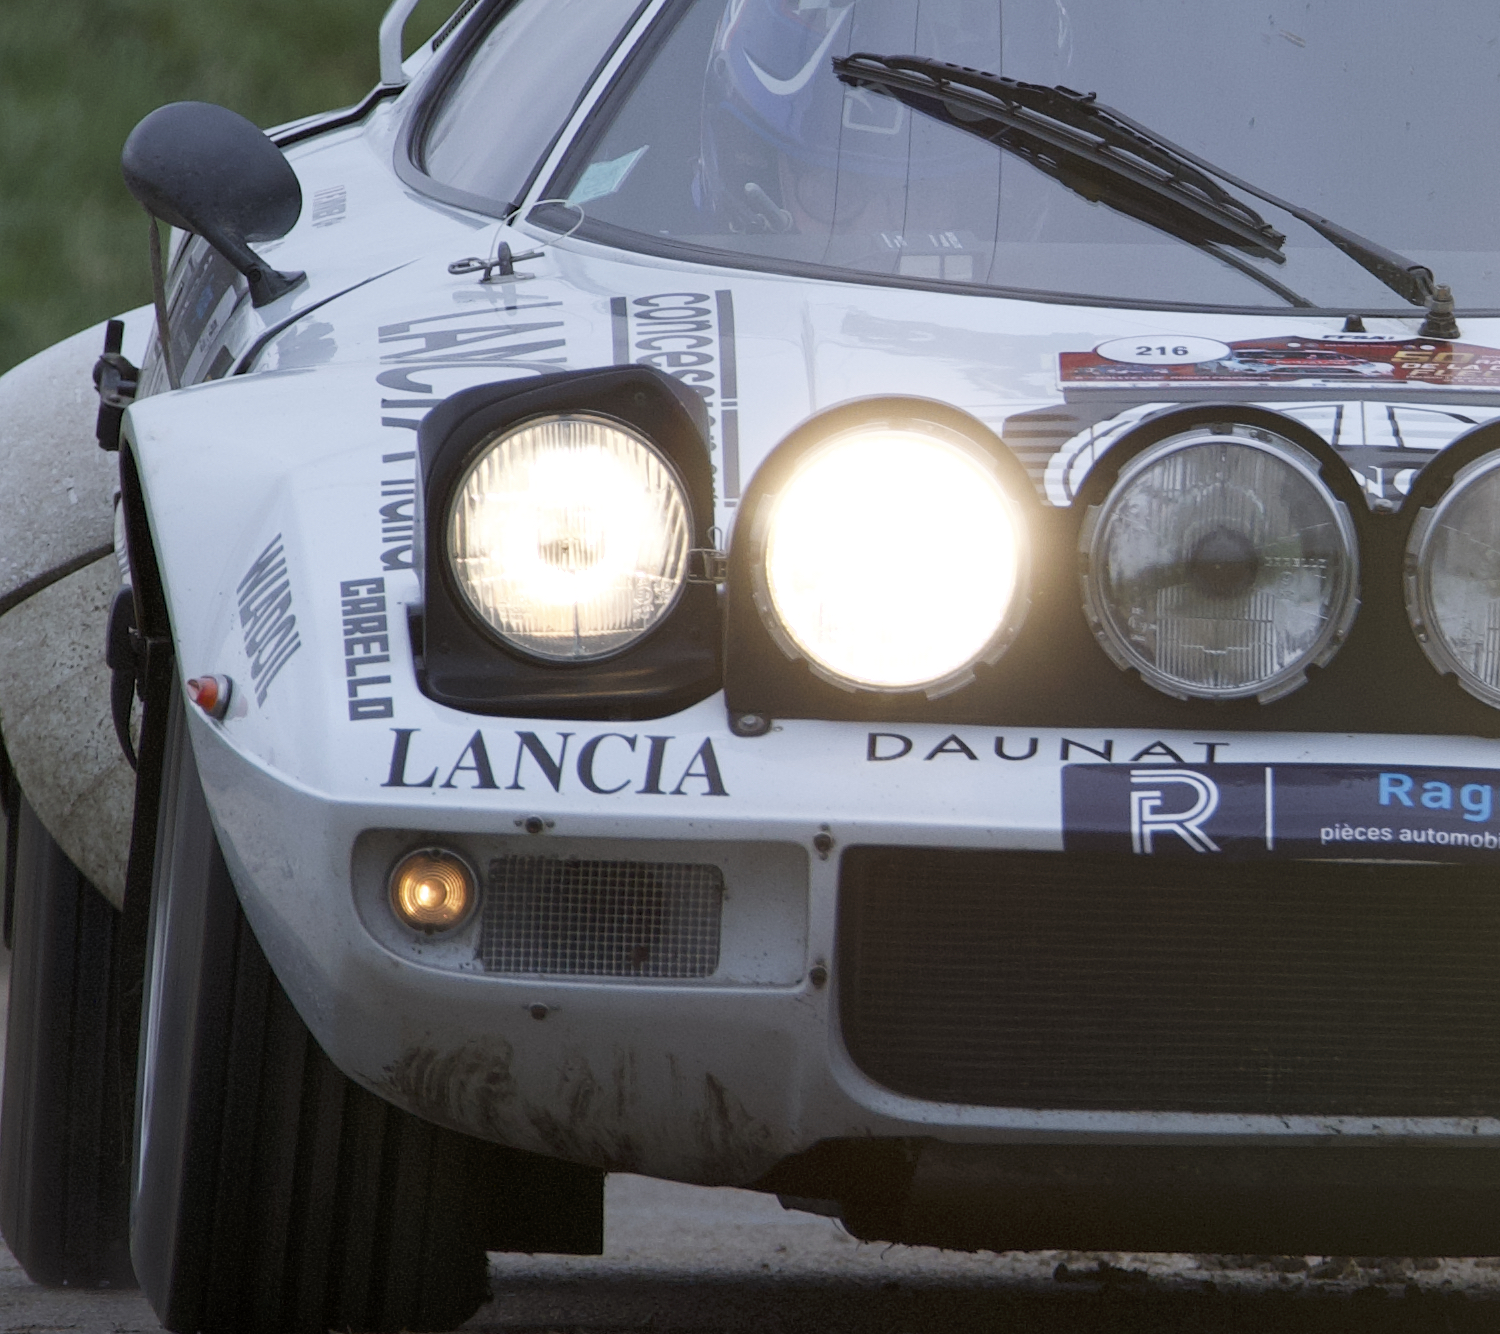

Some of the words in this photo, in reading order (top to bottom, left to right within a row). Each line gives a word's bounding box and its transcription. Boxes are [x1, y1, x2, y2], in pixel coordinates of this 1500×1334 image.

[1135, 345, 1189, 356] 216
[340, 576, 394, 722] CARELLO
[379, 728, 730, 797] LANCIA
[866, 732, 1230, 765] DAUNAT
[1320, 821, 1393, 845] pièces
